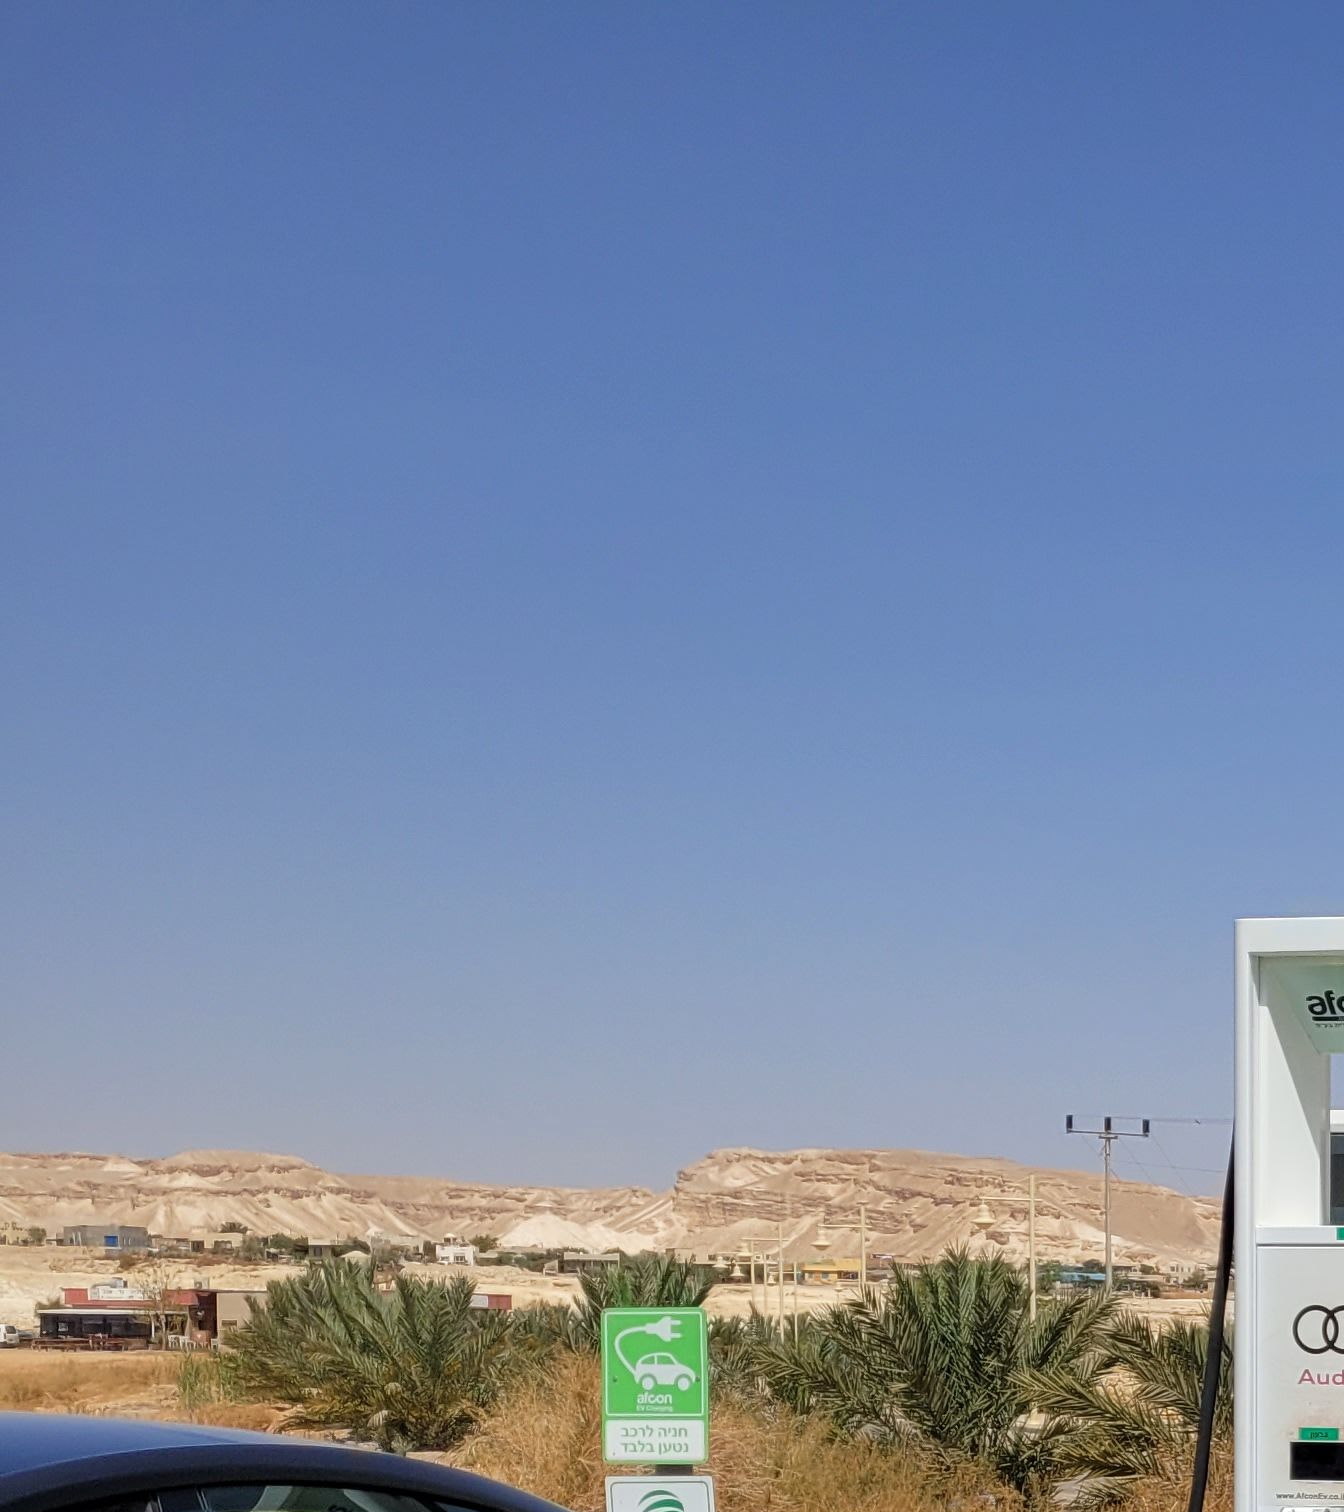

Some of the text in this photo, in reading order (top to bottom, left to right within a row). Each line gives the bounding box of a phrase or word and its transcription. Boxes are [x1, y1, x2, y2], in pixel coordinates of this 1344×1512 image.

[636, 1392, 673, 1405] afcon
[620, 1425, 688, 1438] חניה לרכב
[620, 1440, 689, 1455] נטען בלבד
